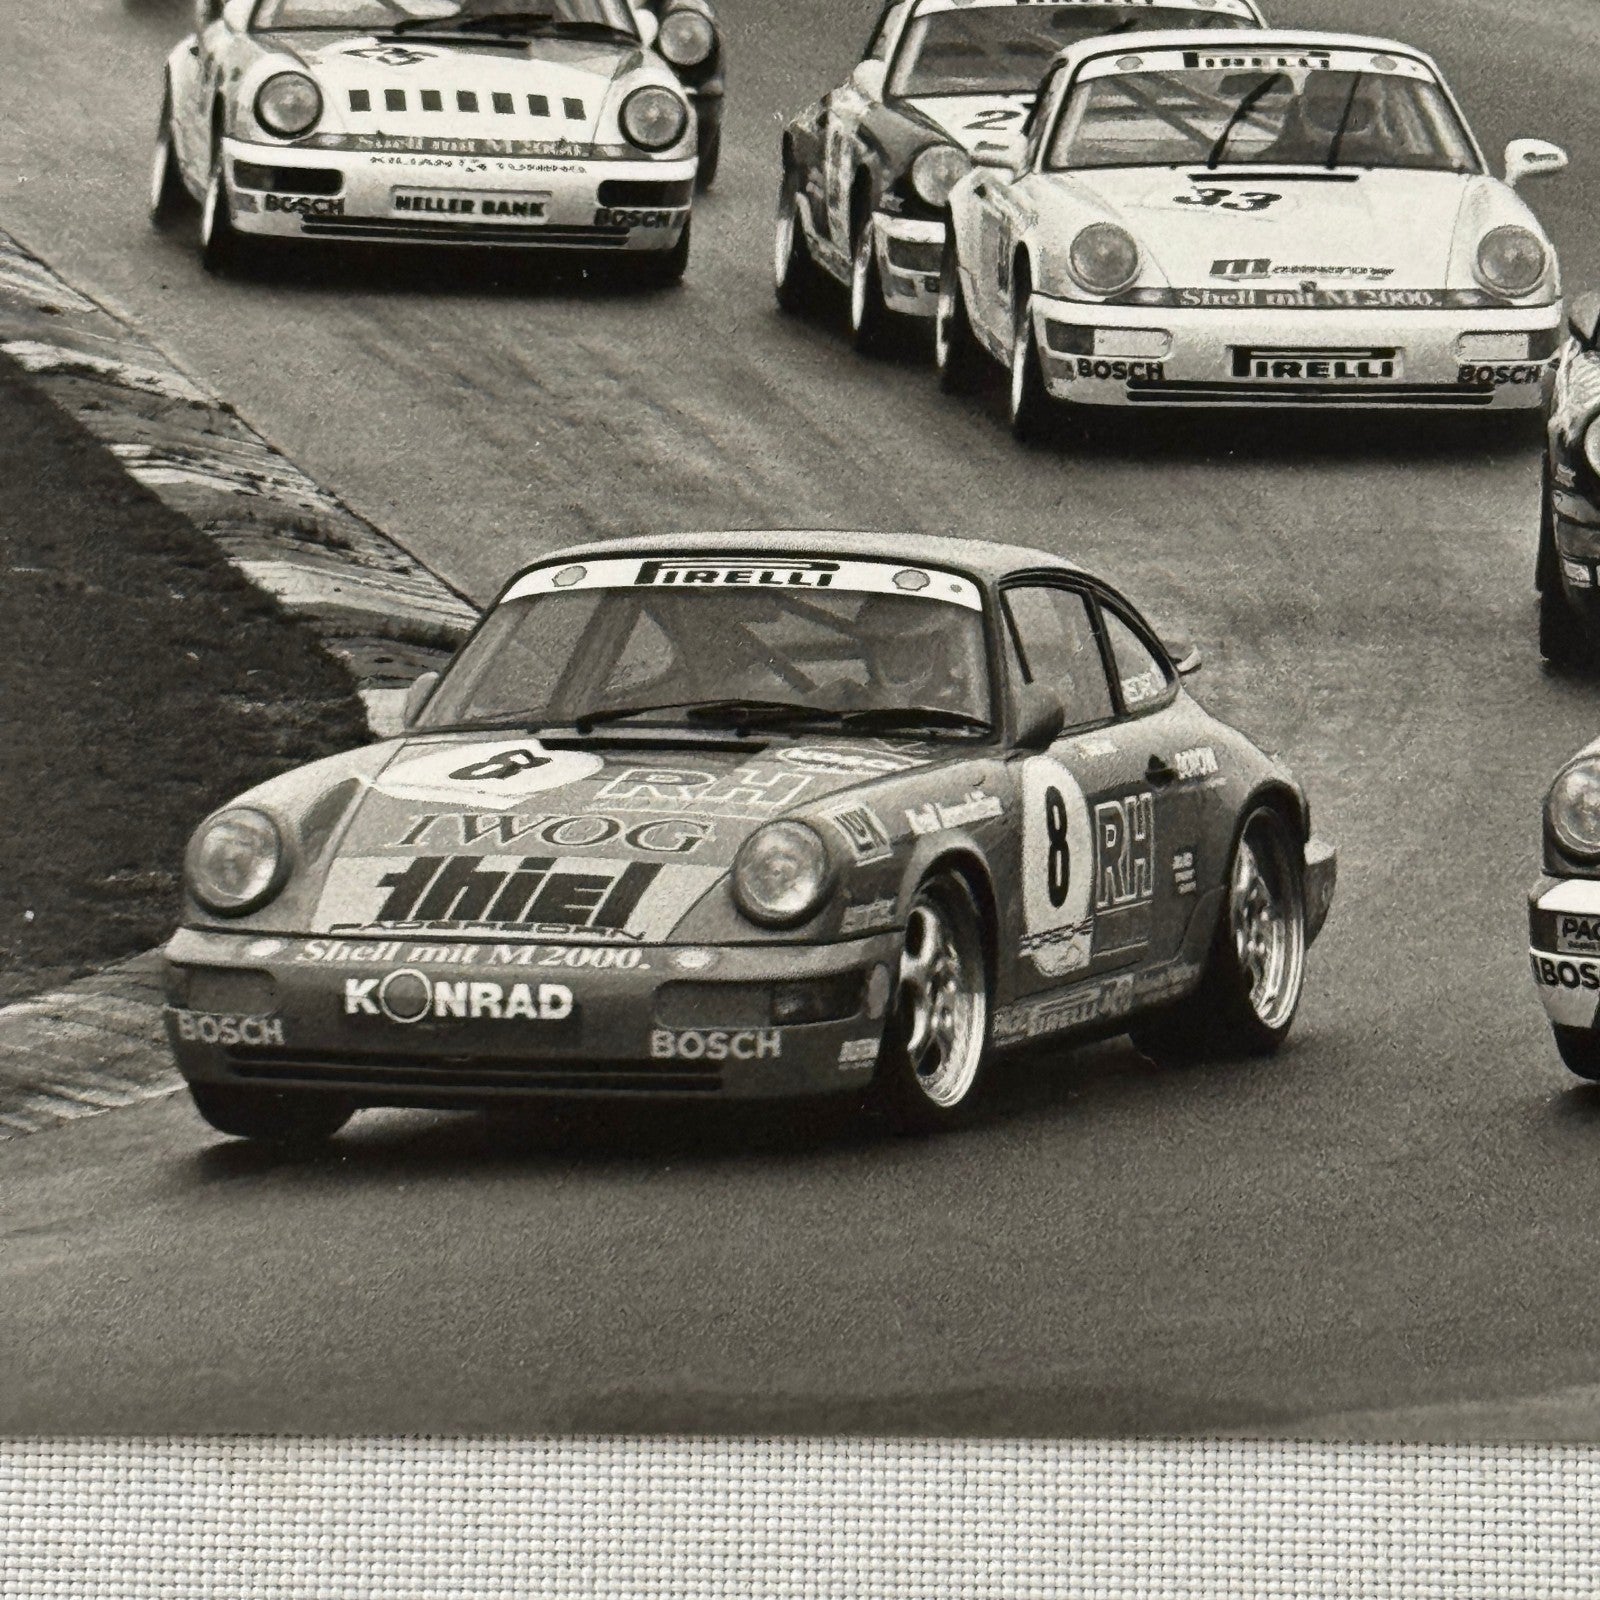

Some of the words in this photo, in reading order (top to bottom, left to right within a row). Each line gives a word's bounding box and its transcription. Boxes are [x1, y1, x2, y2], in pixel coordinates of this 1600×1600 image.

[1172, 184, 1283, 212] 33
[1077, 357, 1166, 381] BOSCH
[1231, 347, 1398, 378] PIRELLI
[1457, 364, 1541, 385] BOSCH
[634, 560, 841, 587] PIRELLI
[447, 749, 553, 781] 8
[1044, 785, 1071, 908] 8
[1094, 791, 1154, 909] RH
[294, 938, 404, 963] Shell
[406, 942, 481, 966] mit
[344, 968, 574, 1024] KONRAD
[178, 1011, 285, 1045] BOSCH
[651, 1029, 782, 1060] BOSCH
